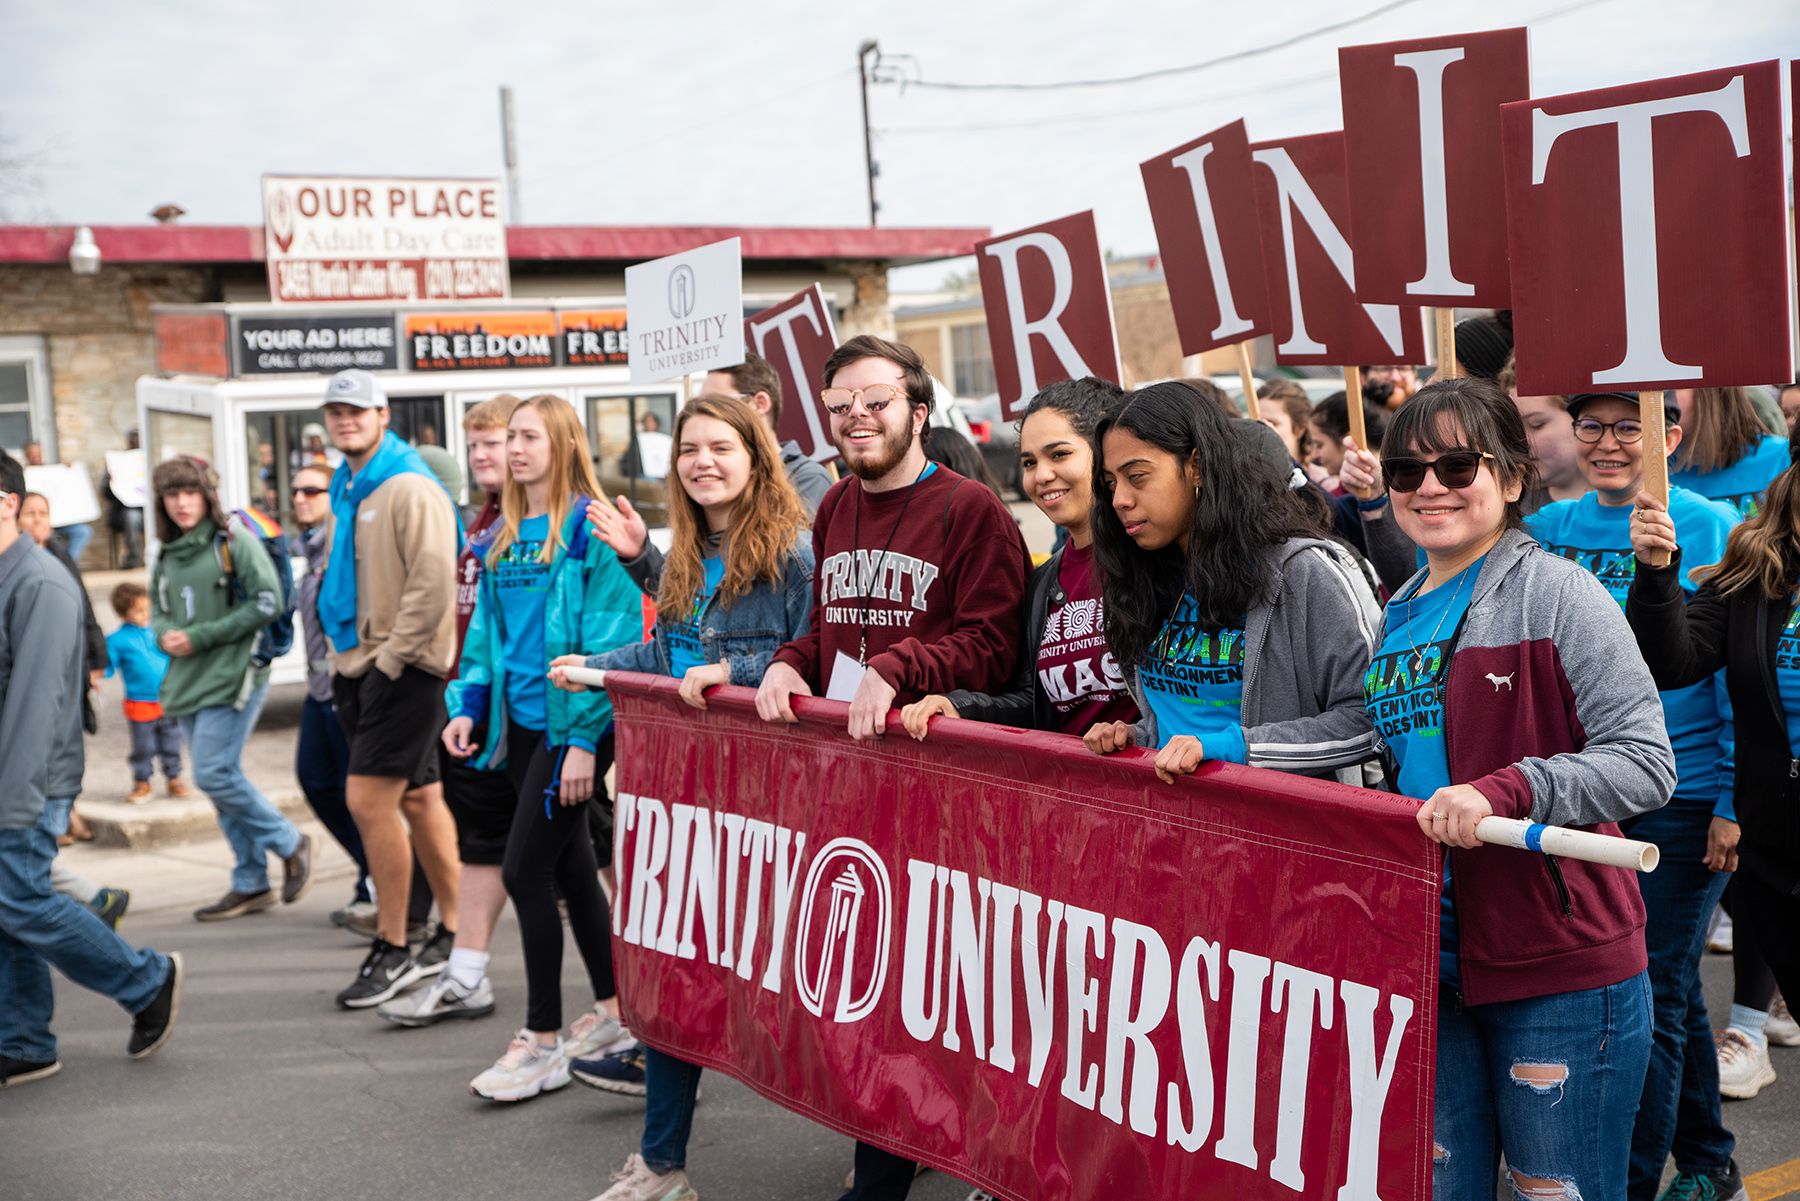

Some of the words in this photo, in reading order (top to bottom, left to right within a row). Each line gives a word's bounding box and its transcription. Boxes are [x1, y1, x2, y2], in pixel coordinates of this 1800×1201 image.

[1394, 47, 1476, 297] I
[299, 187, 373, 218] OUR
[387, 188, 496, 219] PLACE
[303, 226, 374, 251] Adult
[383, 227, 431, 257] Day
[441, 226, 497, 251] Care
[1171, 142, 1254, 340] I
[1252, 147, 1405, 356] N
[1531, 75, 1751, 384] T
[243, 329, 305, 350] YOUR
[305, 328, 338, 349] AD
[338, 327, 394, 348] HERE
[415, 334, 551, 360] FREEDOM
[640, 313, 728, 356] TRINITY
[985, 233, 1096, 412] R
[648, 345, 721, 371] UNIVERSITY
[751, 293, 839, 463] T
[821, 549, 939, 611] TRINITY
[1141, 673, 1199, 698] DESTINY
[1383, 709, 1440, 738] DESINY
[613, 792, 807, 994] TRINITY
[901, 858, 1415, 1201] UNIVERSITY
